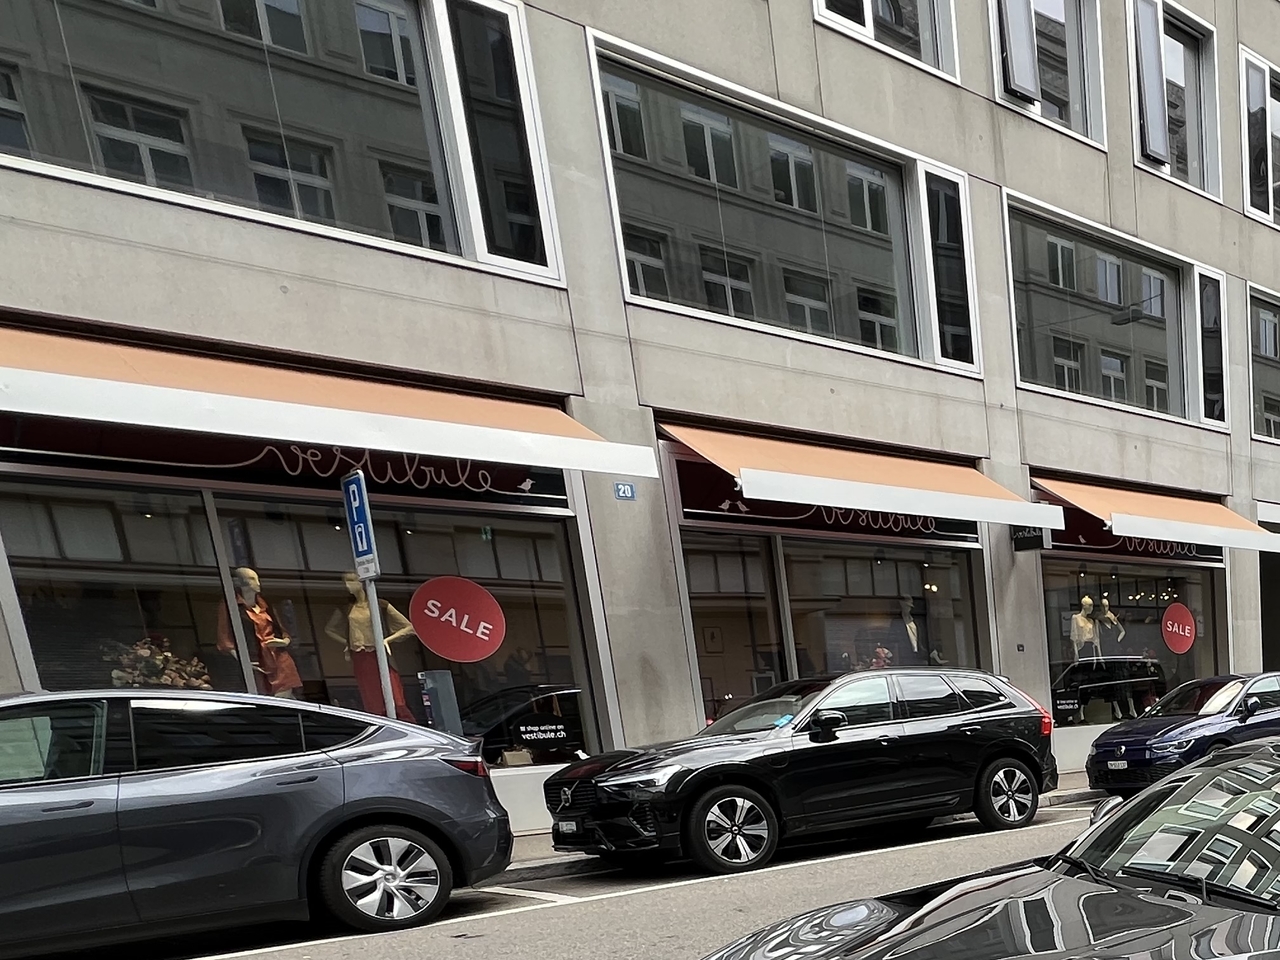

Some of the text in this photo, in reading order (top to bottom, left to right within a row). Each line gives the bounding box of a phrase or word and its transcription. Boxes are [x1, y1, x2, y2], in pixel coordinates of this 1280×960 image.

[618, 484, 632, 497] 20
[348, 483, 360, 522] P
[423, 599, 494, 641] SALE
[1166, 620, 1192, 638] SALE
[521, 730, 566, 740] vestibule.ch
